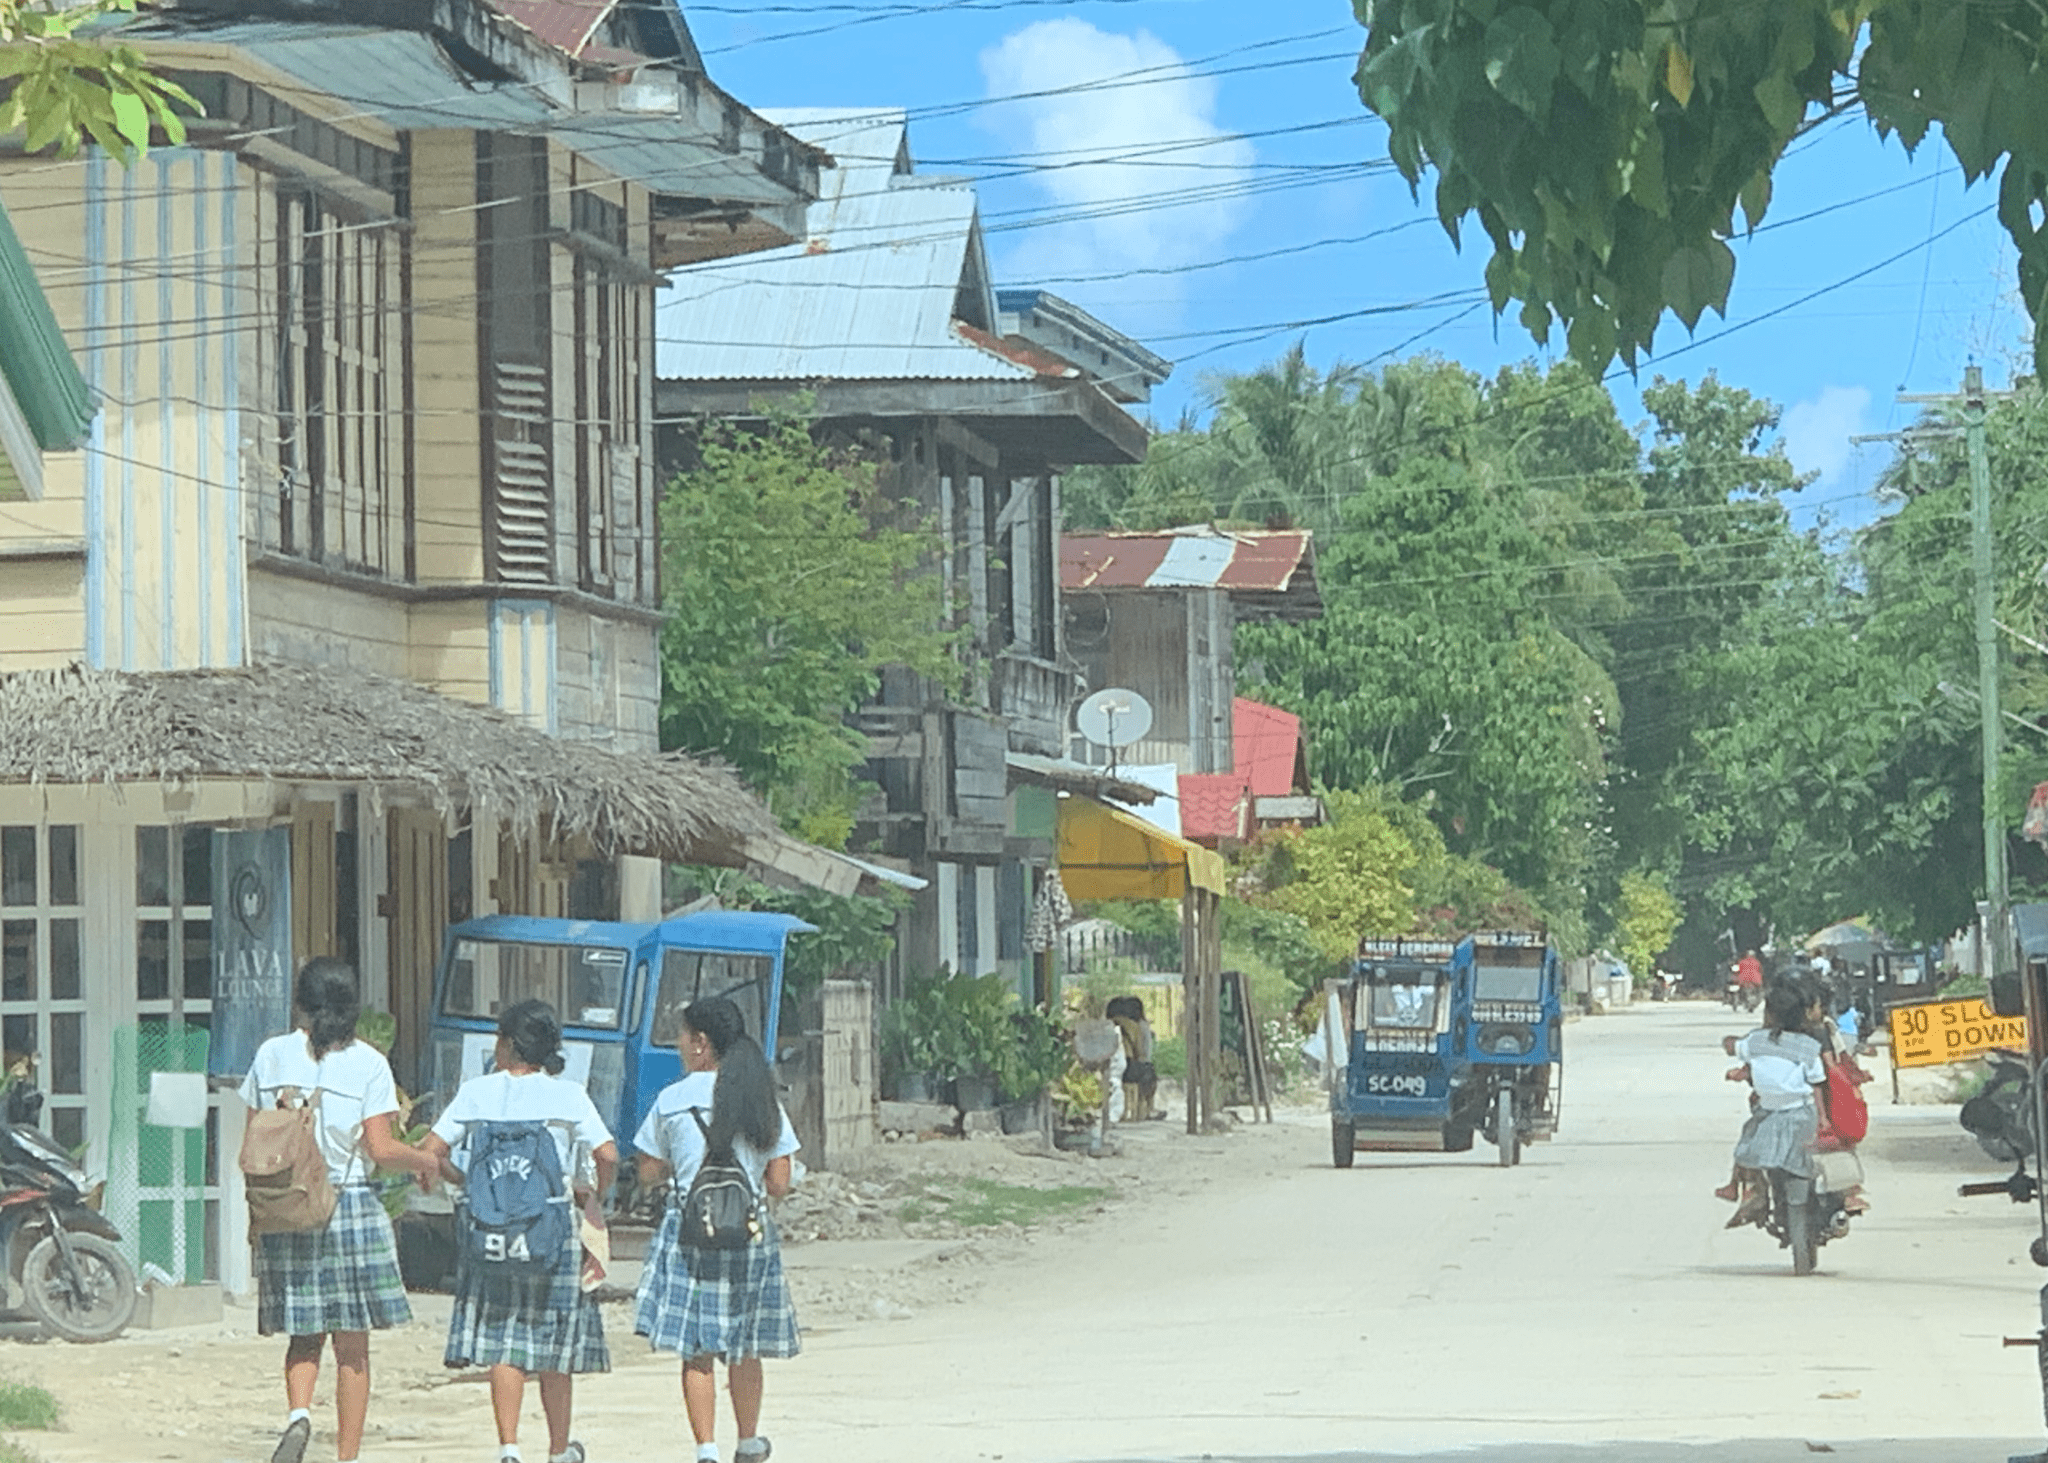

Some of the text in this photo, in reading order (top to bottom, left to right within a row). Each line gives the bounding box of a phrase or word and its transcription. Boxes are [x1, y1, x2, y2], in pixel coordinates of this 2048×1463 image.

[1899, 1008, 1929, 1037] 30
[1940, 1001, 1995, 1026] SLO
[1945, 1021, 2026, 1048] DOWN
[485, 1233, 531, 1262] 94
